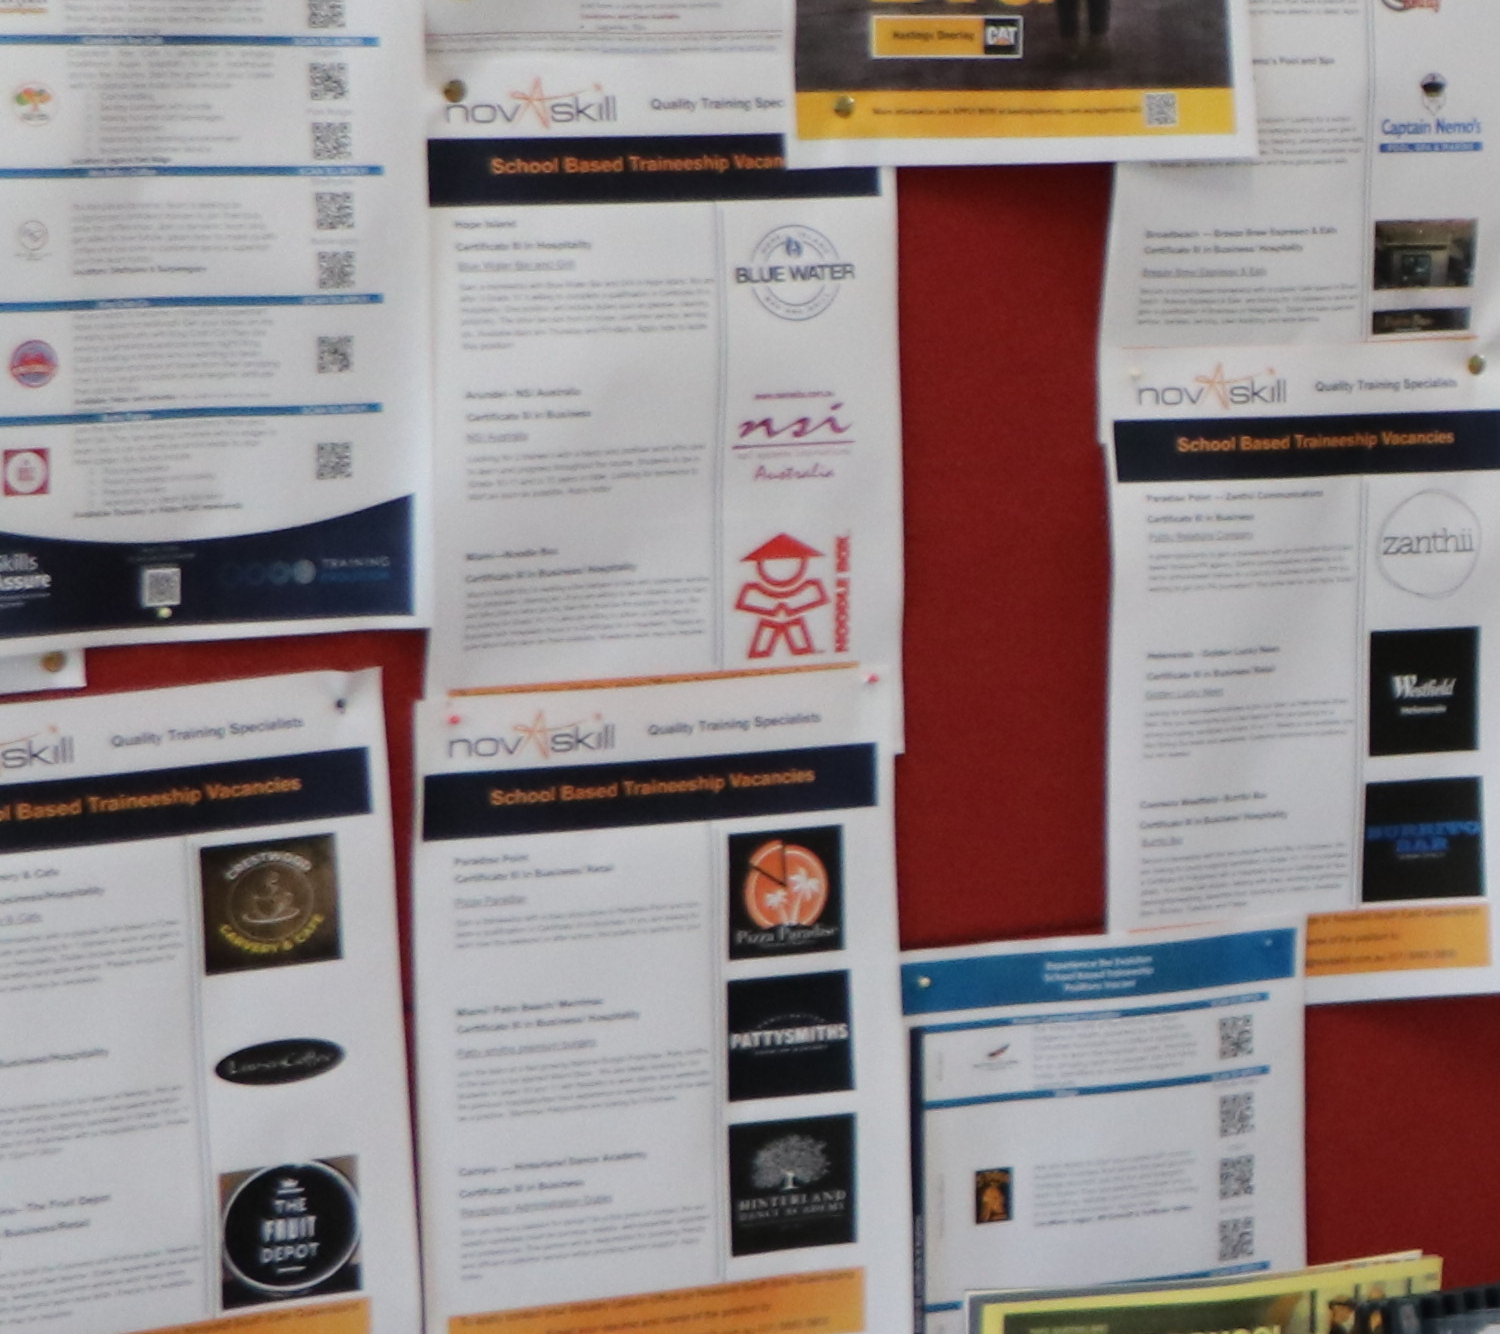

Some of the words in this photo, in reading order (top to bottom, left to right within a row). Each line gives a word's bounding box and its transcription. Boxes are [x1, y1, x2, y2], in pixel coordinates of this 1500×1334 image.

[986, 27, 1017, 45] CAT
[1382, 119, 1431, 137] Captain
[1436, 119, 1481, 133] Nemo's
[736, 265, 788, 284] BLUE
[790, 263, 855, 282] WATER
[1383, 528, 1474, 556] zanthii
[730, 1023, 848, 1049] PATTYSMITHS
[274, 1198, 307, 1212] THE
[260, 1242, 320, 1263] DEPOT
